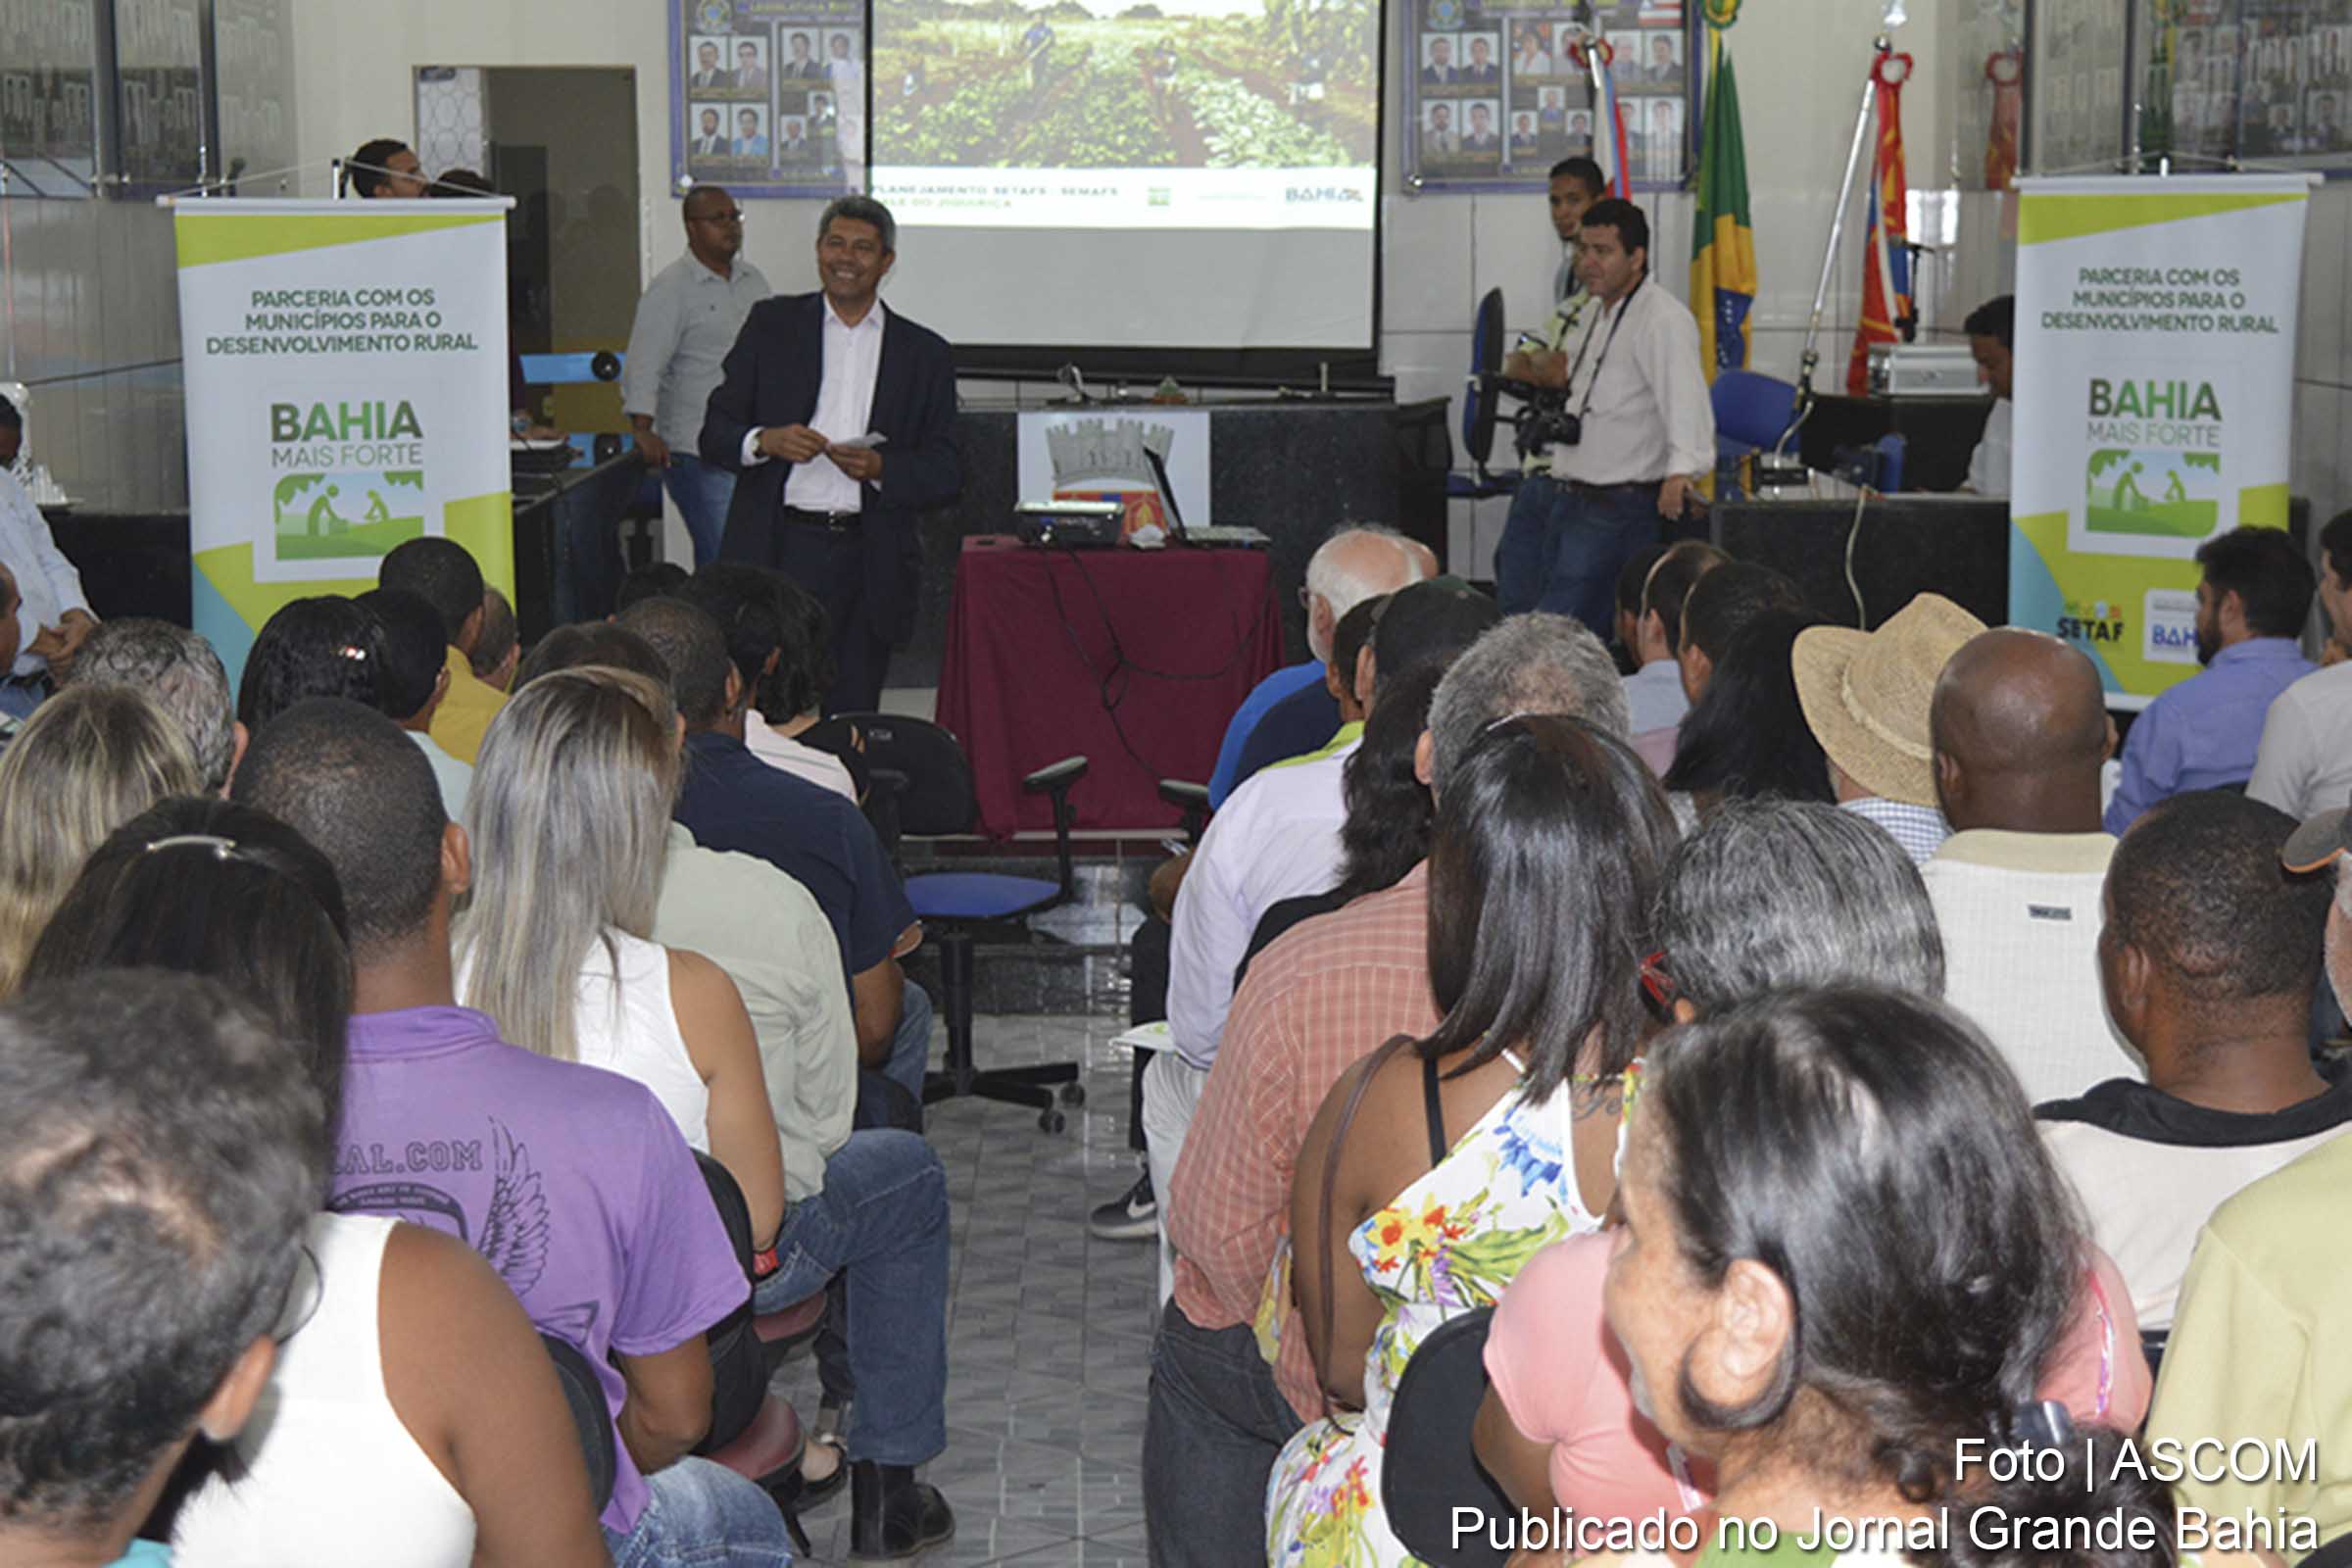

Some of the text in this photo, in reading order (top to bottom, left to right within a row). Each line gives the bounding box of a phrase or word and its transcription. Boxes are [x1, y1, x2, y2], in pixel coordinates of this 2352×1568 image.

[2079, 268, 2240, 287] PARCERIA COM OS
[251, 288, 435, 308] PARCERIA COM OS
[2072, 288, 2245, 310] MUNICÍPIOS PARA O
[245, 309, 442, 331] MUNICÍPIOS PARA O
[2041, 312, 2279, 334] DESENVOLVIMENTO RURAL
[206, 332, 479, 356] DESENVOLVIMENTO RURAL
[2088, 378, 2223, 421] BAHIA
[270, 400, 424, 442] BAHIA
[2086, 421, 2221, 448] MAIS FORTE
[270, 443, 423, 467] MAIS FORTE
[2056, 616, 2125, 643] SETAF
